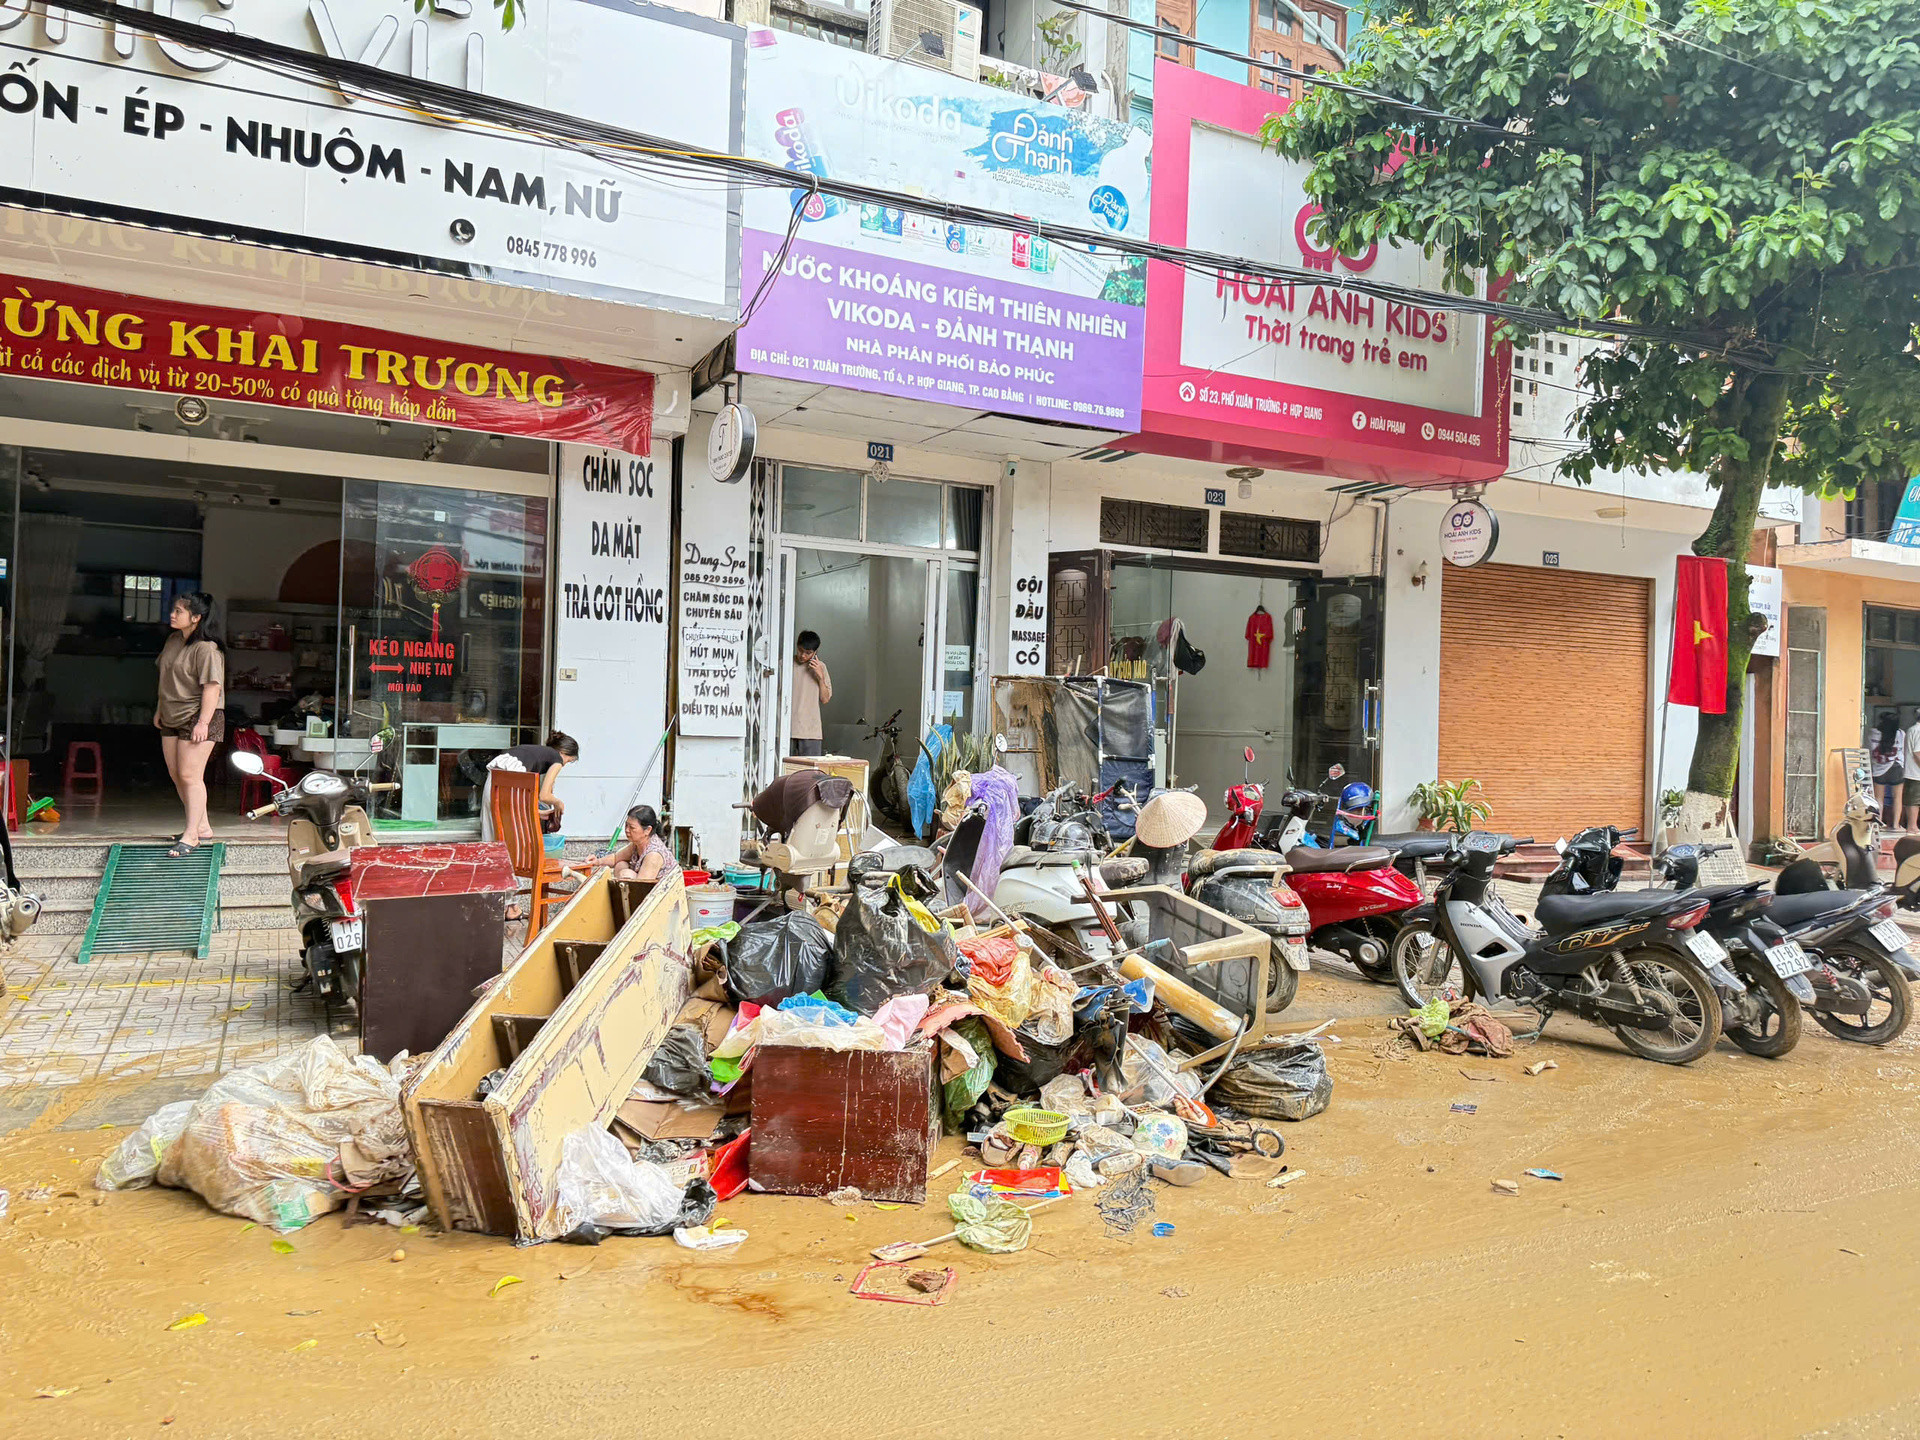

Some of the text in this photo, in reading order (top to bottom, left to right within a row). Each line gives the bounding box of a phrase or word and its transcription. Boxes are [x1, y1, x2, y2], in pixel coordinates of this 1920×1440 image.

[124, 87, 185, 140] ÉP
[226, 116, 406, 185] NHUỘM
[444, 158, 557, 215] NAM,
[565, 179, 623, 223] NỮ
[507, 236, 597, 268] 0845 778 996
[762, 249, 1127, 340] NƯỚC KHOÁNG KIỀM THIÊN NHIÊN
[1307, 286, 1374, 328] ANH
[1386, 300, 1447, 343] KIDS
[827, 298, 916, 333] VIKODA
[935, 314, 997, 348] ĐẢNH
[1002, 330, 1074, 361] THẠNH
[1245, 314, 1427, 372] Thời trang trẻ em
[169, 321, 319, 374] KHAI
[339, 344, 565, 407] TRƯƠNG
[846, 336, 1055, 385] NHÀ PHÂN PHỐI BẢO PHÚC
[21, 347, 43, 371] cả
[51, 351, 85, 375] các
[91, 356, 131, 385] dịch
[139, 366, 161, 390] vụ
[168, 367, 190, 389] từ
[195, 371, 274, 399] 20-50%
[281, 381, 301, 401] có
[307, 385, 339, 410] quà
[346, 388, 383, 417] tặng
[389, 387, 420, 422] hấp
[426, 394, 457, 423] dẫn
[750, 348, 768, 363] ĐỊA
[770, 350, 790, 366] CHỈ:
[792, 355, 810, 368] 021
[813, 358, 840, 374] XUÂN
[917, 376, 935, 390] HỢP
[937, 379, 967, 394] GIANG,
[969, 384, 980, 396] TP.
[982, 387, 999, 399] CAO
[1001, 386, 1024, 403] BẰNG
[1036, 395, 1072, 410] HOTLINE:
[1199, 387, 1210, 402] SỐ
[1235, 393, 1253, 410] XUÂN
[1290, 404, 1303, 418] HỢP
[1304, 406, 1323, 420] GIANG
[1437, 427, 1454, 443] 0944
[1454, 429, 1468, 445] 504
[1468, 432, 1481, 447] 495
[869, 443, 892, 459] 021
[583, 448, 653, 498] CHĂM SÓC
[1206, 490, 1225, 504] 023
[592, 515, 641, 565] DA MẶT
[684, 542, 746, 574] Dung Spa
[1544, 553, 1559, 565] 025
[684, 572, 745, 585] 085 929 3896
[1016, 575, 1043, 598] GỘI
[564, 573, 663, 624] TRÀ GÓT HỒNG
[712, 592, 731, 605] SÓC
[732, 595, 745, 606] DA
[1015, 598, 1044, 620] ĐẦU
[685, 606, 743, 620] CHUYÊN SÂU
[369, 636, 455, 660] KÉO NGANG
[1011, 629, 1045, 643] MASSAGE
[690, 643, 735, 663] HÚT MỤN
[1016, 644, 1040, 665] CỔ
[410, 661, 453, 678] NHẸ TAY
[704, 704, 719, 718] TRỊ
[721, 702, 743, 716] NÁM
[1776, 956, 1809, 977] 572.92
